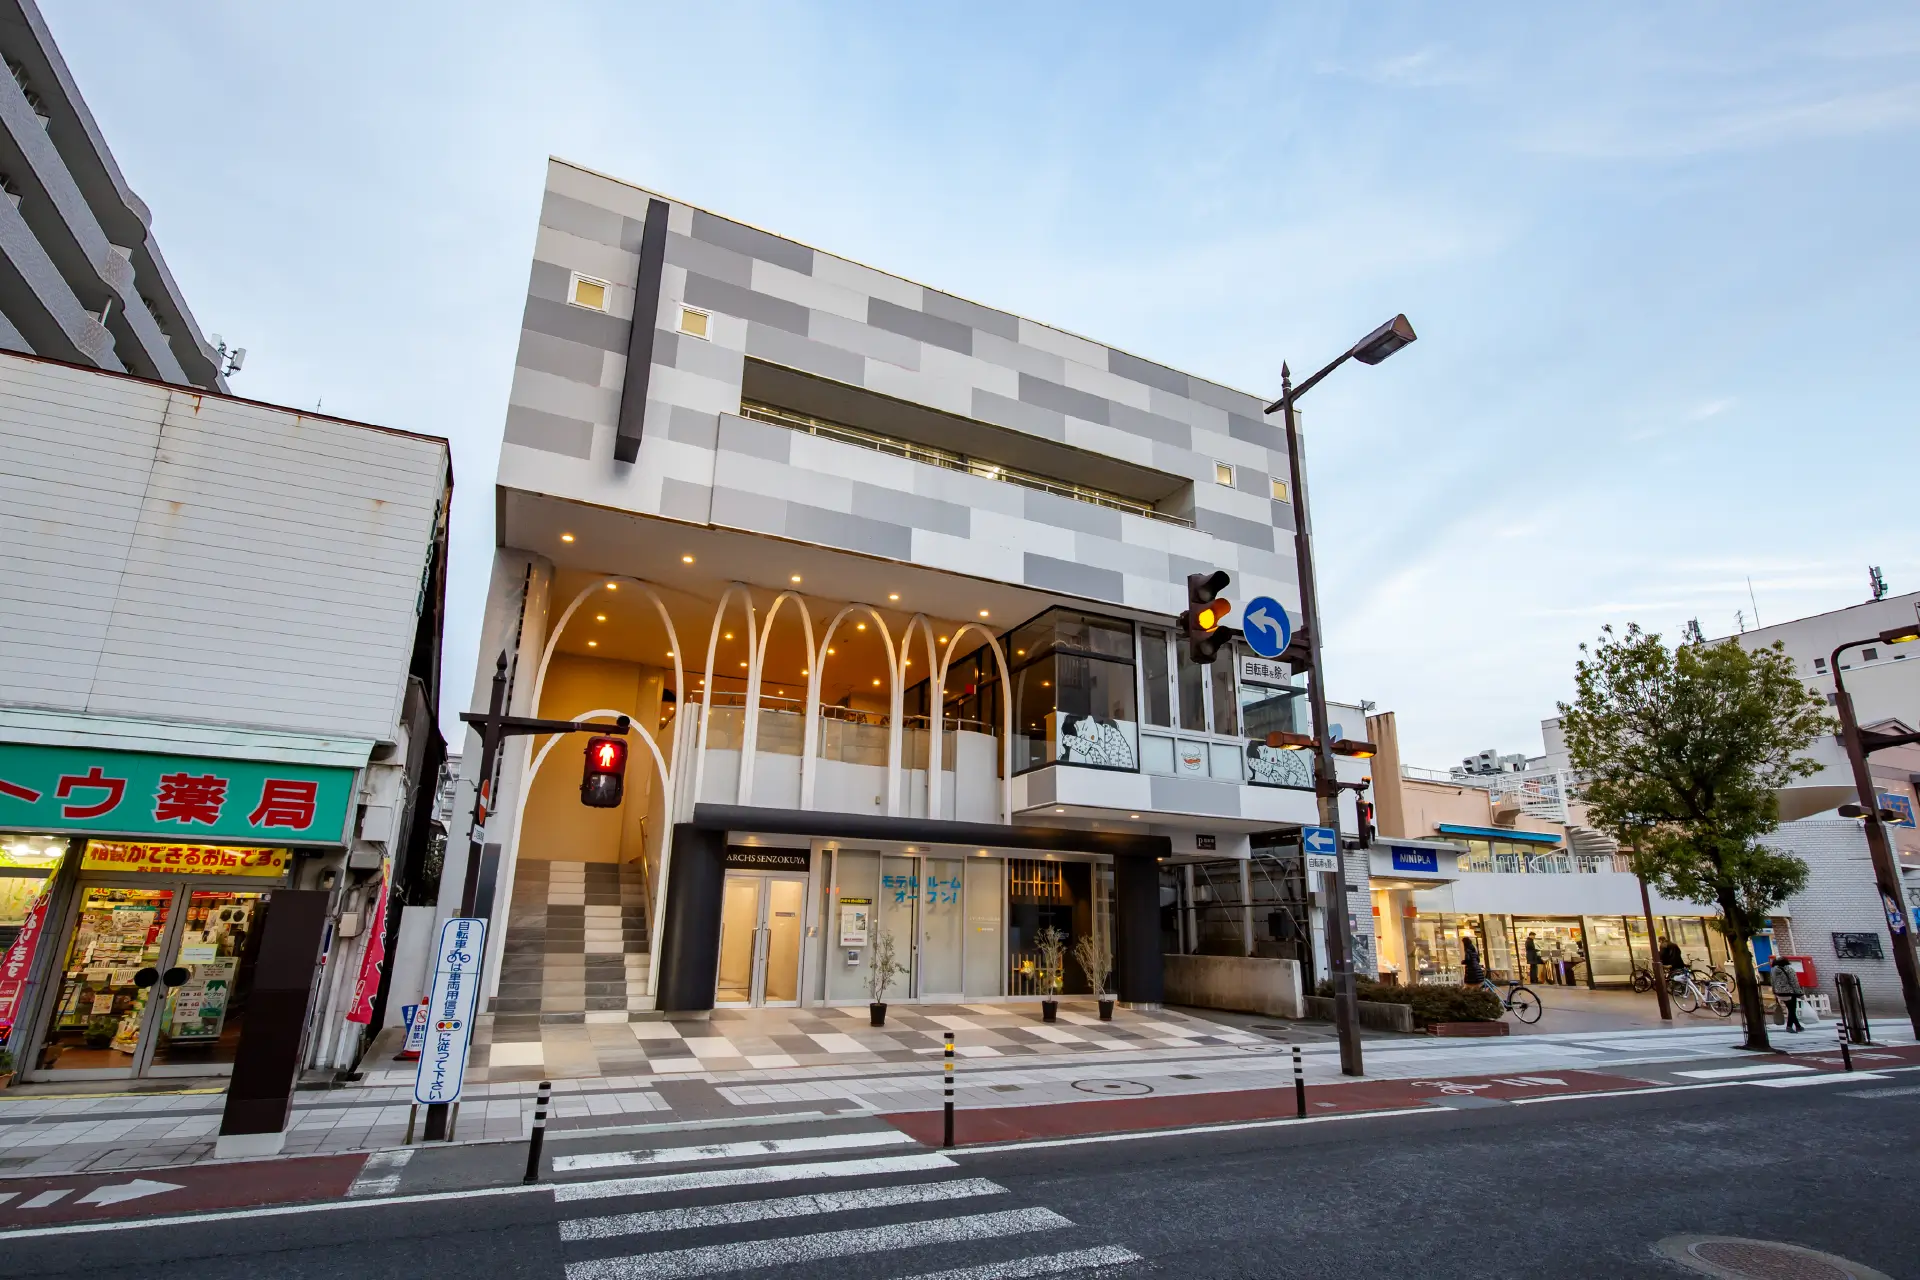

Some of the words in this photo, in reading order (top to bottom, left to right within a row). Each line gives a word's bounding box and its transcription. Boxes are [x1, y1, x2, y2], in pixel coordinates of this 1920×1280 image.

[1245, 662, 1287, 680] 自転車を除く
[91, 843, 281, 867] 相談ができるお店です。
[727, 854, 756, 862] ARCHS
[757, 855, 805, 865] SENZOKUYA
[454, 921, 470, 949] 自転車
[442, 962, 463, 1020] は車両用信号
[429, 1032, 451, 1101] に従って下さい
